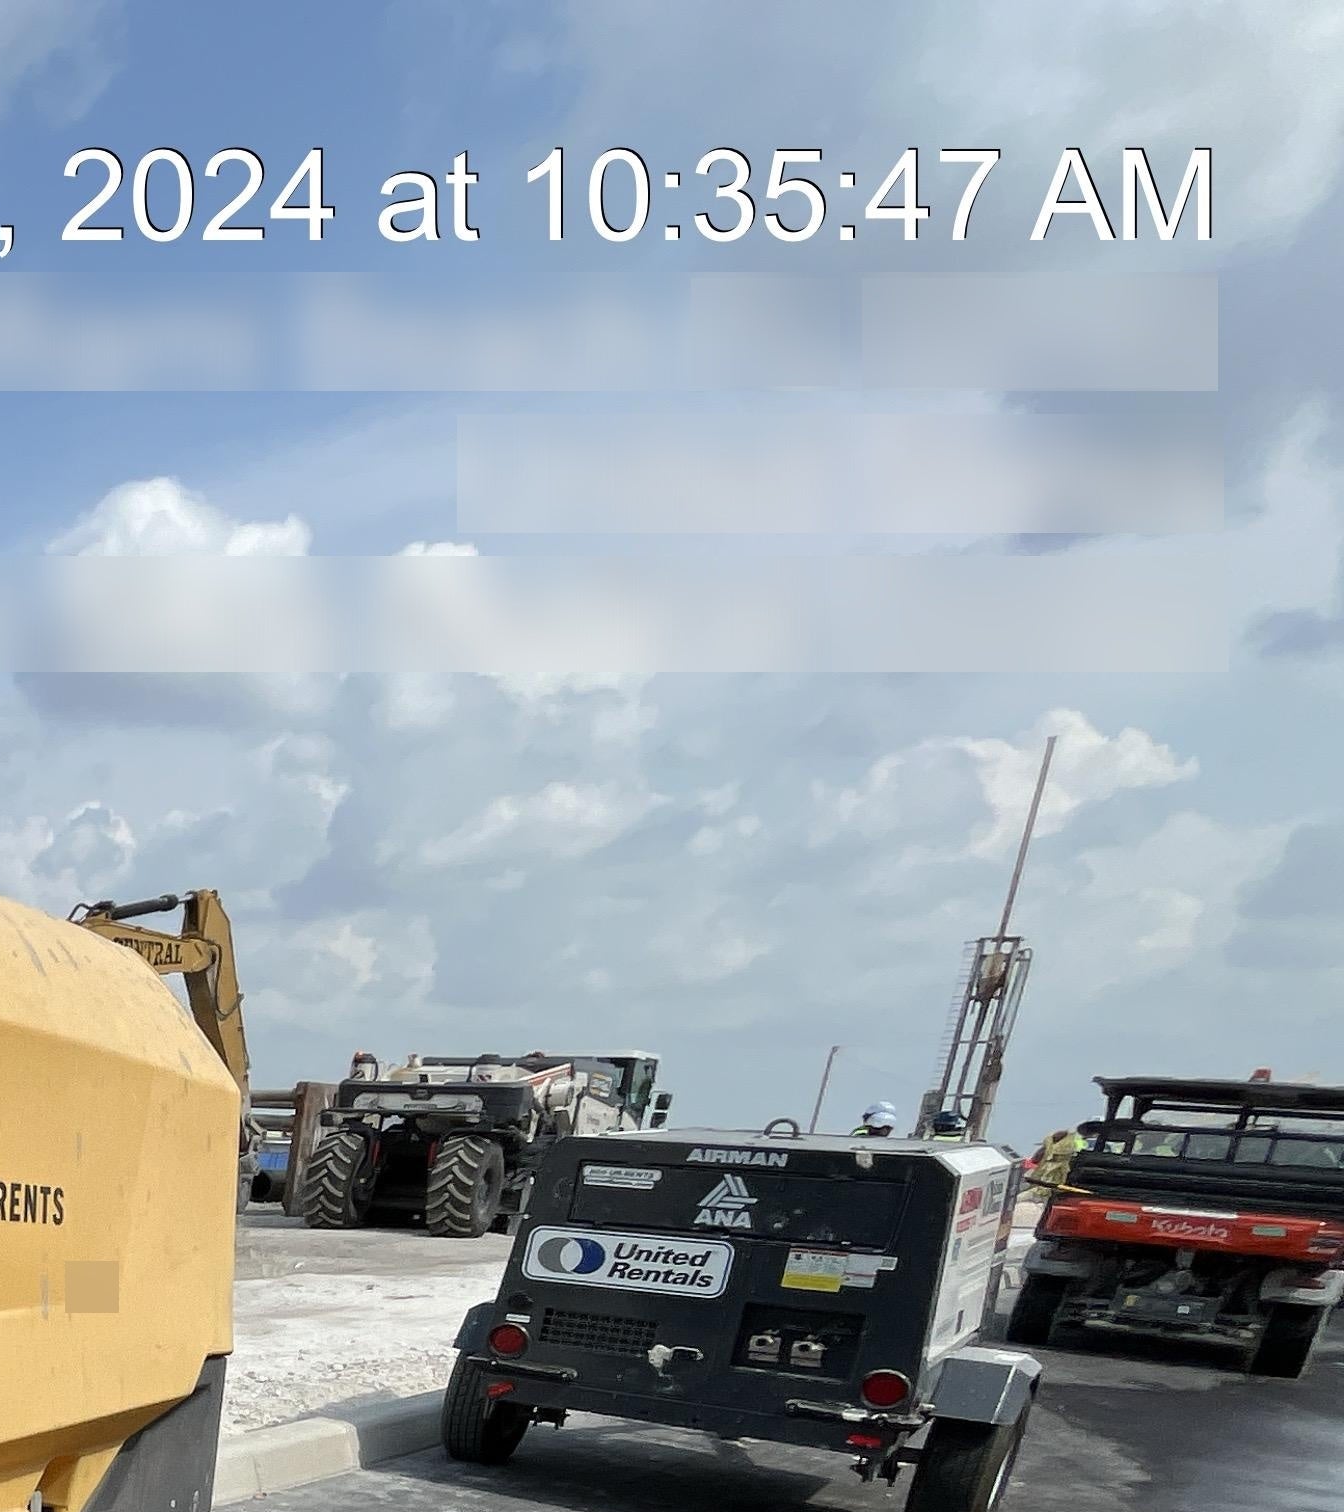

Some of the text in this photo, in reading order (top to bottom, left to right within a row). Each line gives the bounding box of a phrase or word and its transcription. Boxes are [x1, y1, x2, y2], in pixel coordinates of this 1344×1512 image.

[686, 1148, 789, 1168] AIRMAN
[693, 1208, 752, 1229] ANA
[613, 1242, 713, 1267] United
[607, 1261, 714, 1288] Rentals
